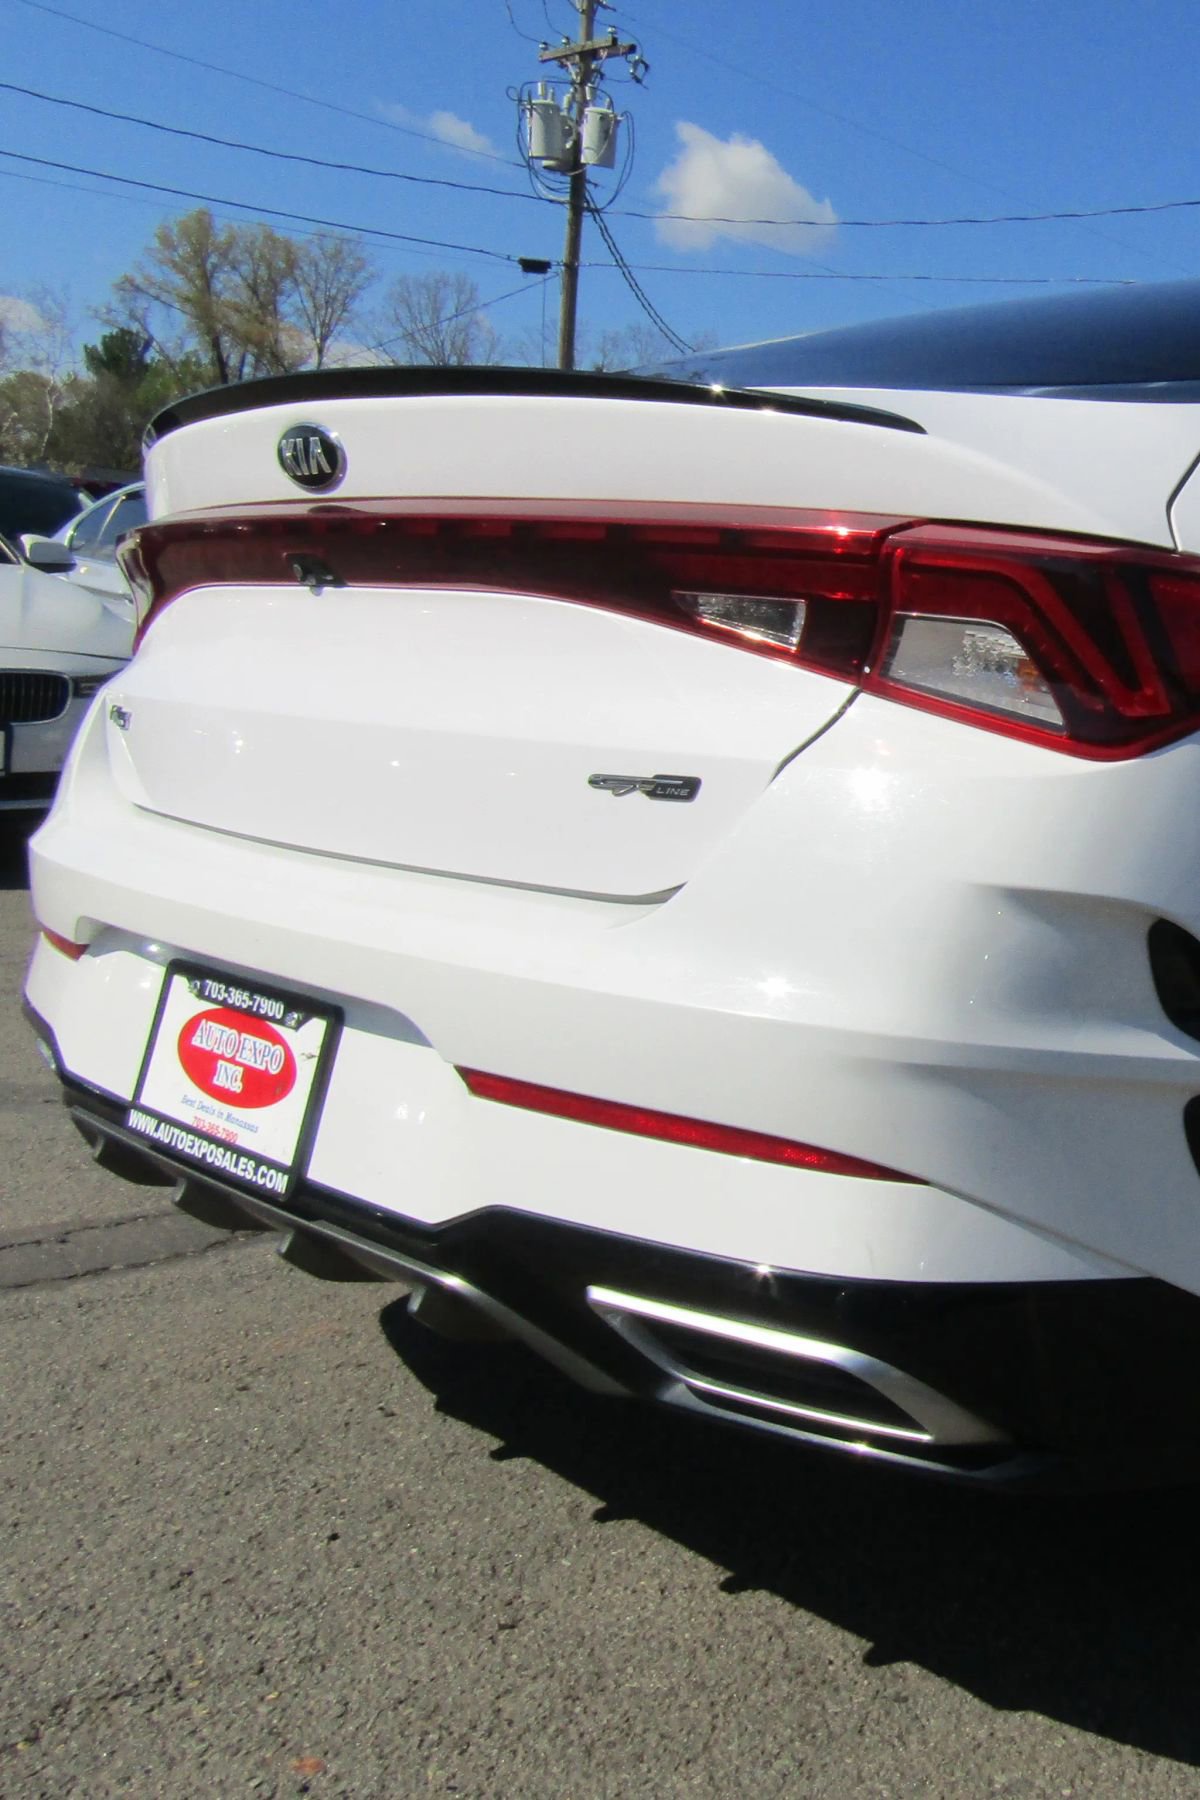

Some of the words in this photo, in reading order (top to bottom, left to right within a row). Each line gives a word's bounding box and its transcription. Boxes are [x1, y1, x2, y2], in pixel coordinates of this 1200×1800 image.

[281, 437, 332, 476] KIA
[656, 787, 690, 796] LINE
[204, 979, 285, 1020] 703-365-7900
[192, 1019, 240, 1058] AUTO
[236, 1033, 285, 1074] EXPO
[213, 1060, 243, 1093] INC.
[128, 1109, 289, 1194] WWW.AUTOEXPOSALES.COM
